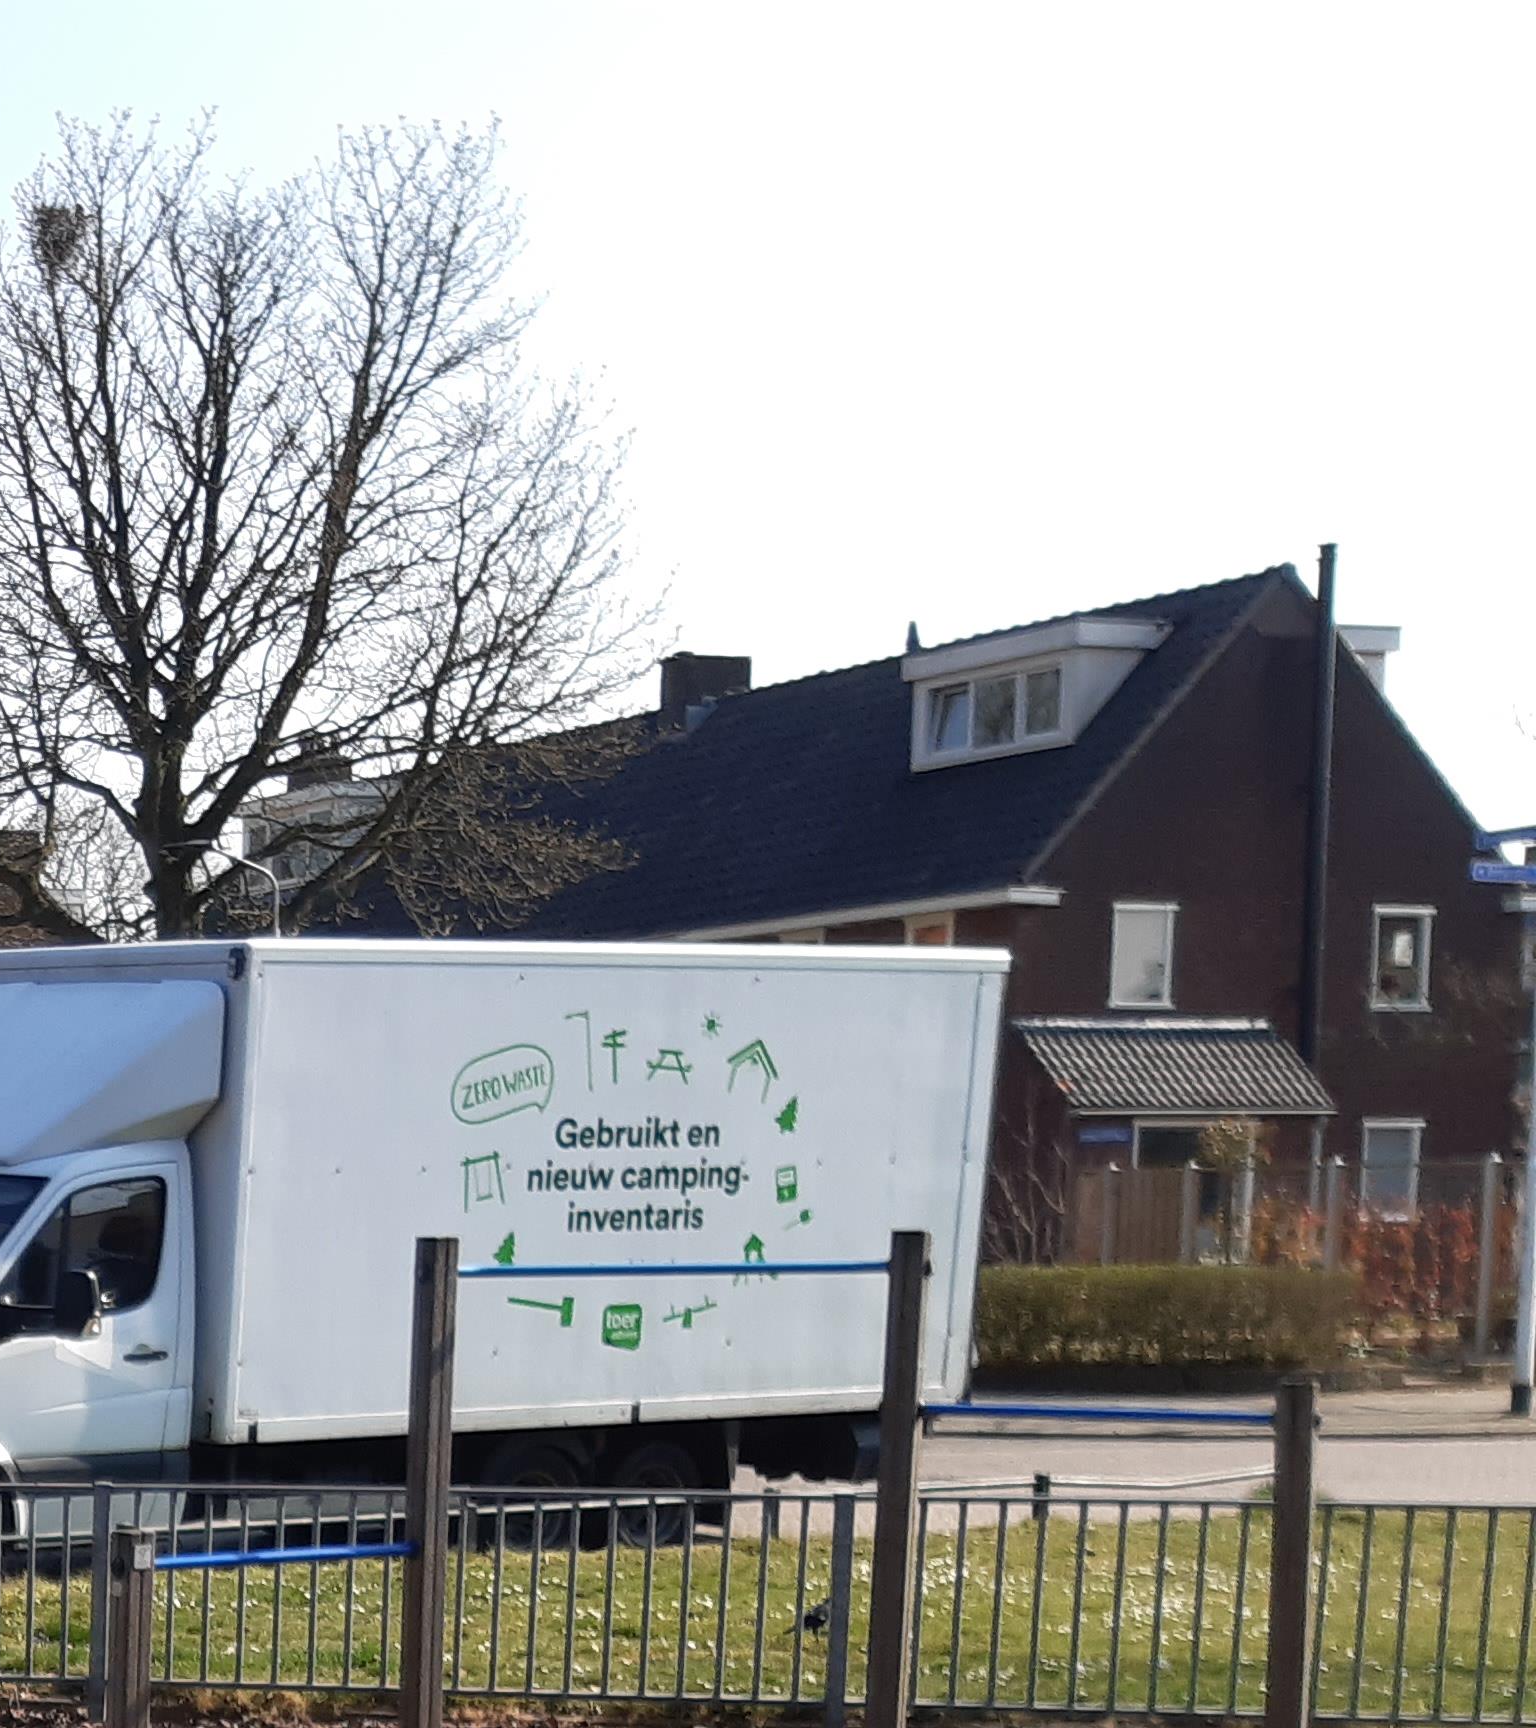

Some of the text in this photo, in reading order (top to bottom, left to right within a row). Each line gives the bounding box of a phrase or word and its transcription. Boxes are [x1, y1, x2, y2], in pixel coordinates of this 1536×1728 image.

[461, 1064, 547, 1109] ZERO WASTE
[554, 1117, 720, 1149] Gebruikt en
[527, 1156, 750, 1195] nieuw camping-
[567, 1199, 704, 1232] inventaris
